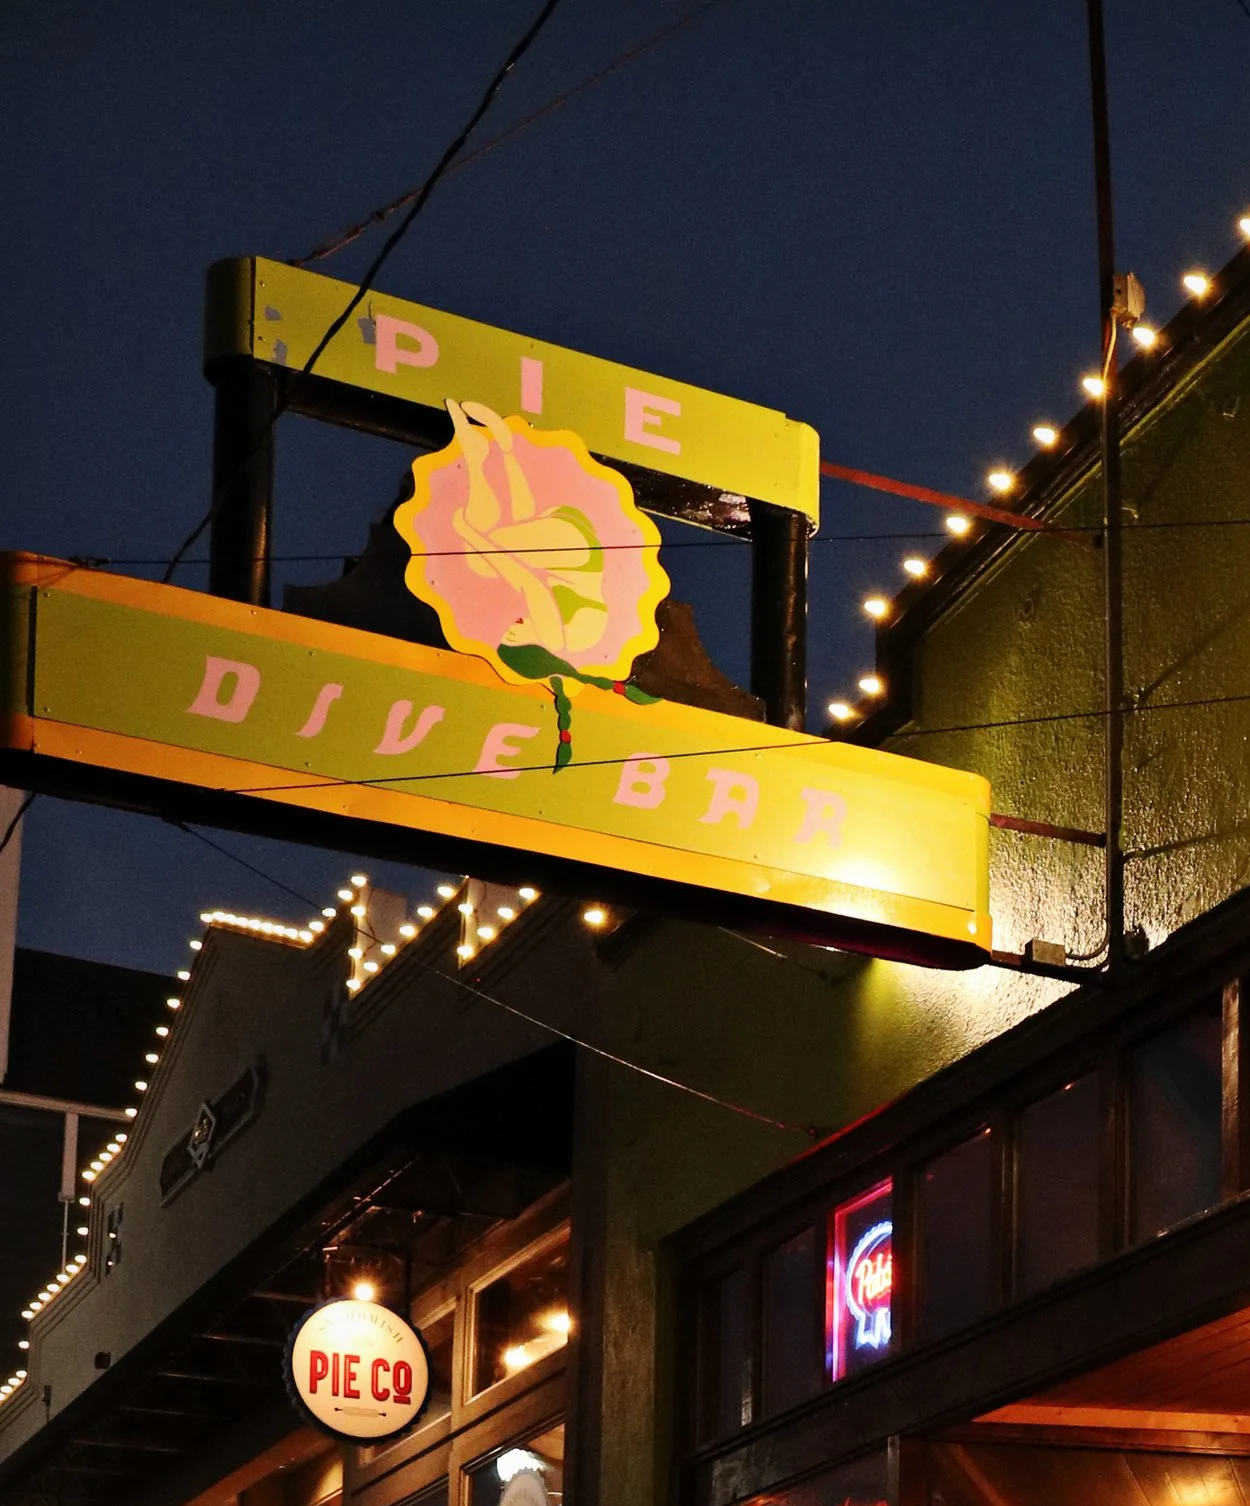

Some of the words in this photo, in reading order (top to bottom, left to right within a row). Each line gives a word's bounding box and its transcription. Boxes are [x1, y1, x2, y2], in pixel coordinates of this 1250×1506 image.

[374, 313, 681, 456] PIE
[185, 655, 541, 780] DIVE
[611, 751, 849, 850] BAR
[319, 1309, 404, 1343] SNHOMISH
[309, 1350, 361, 1400] PIE
